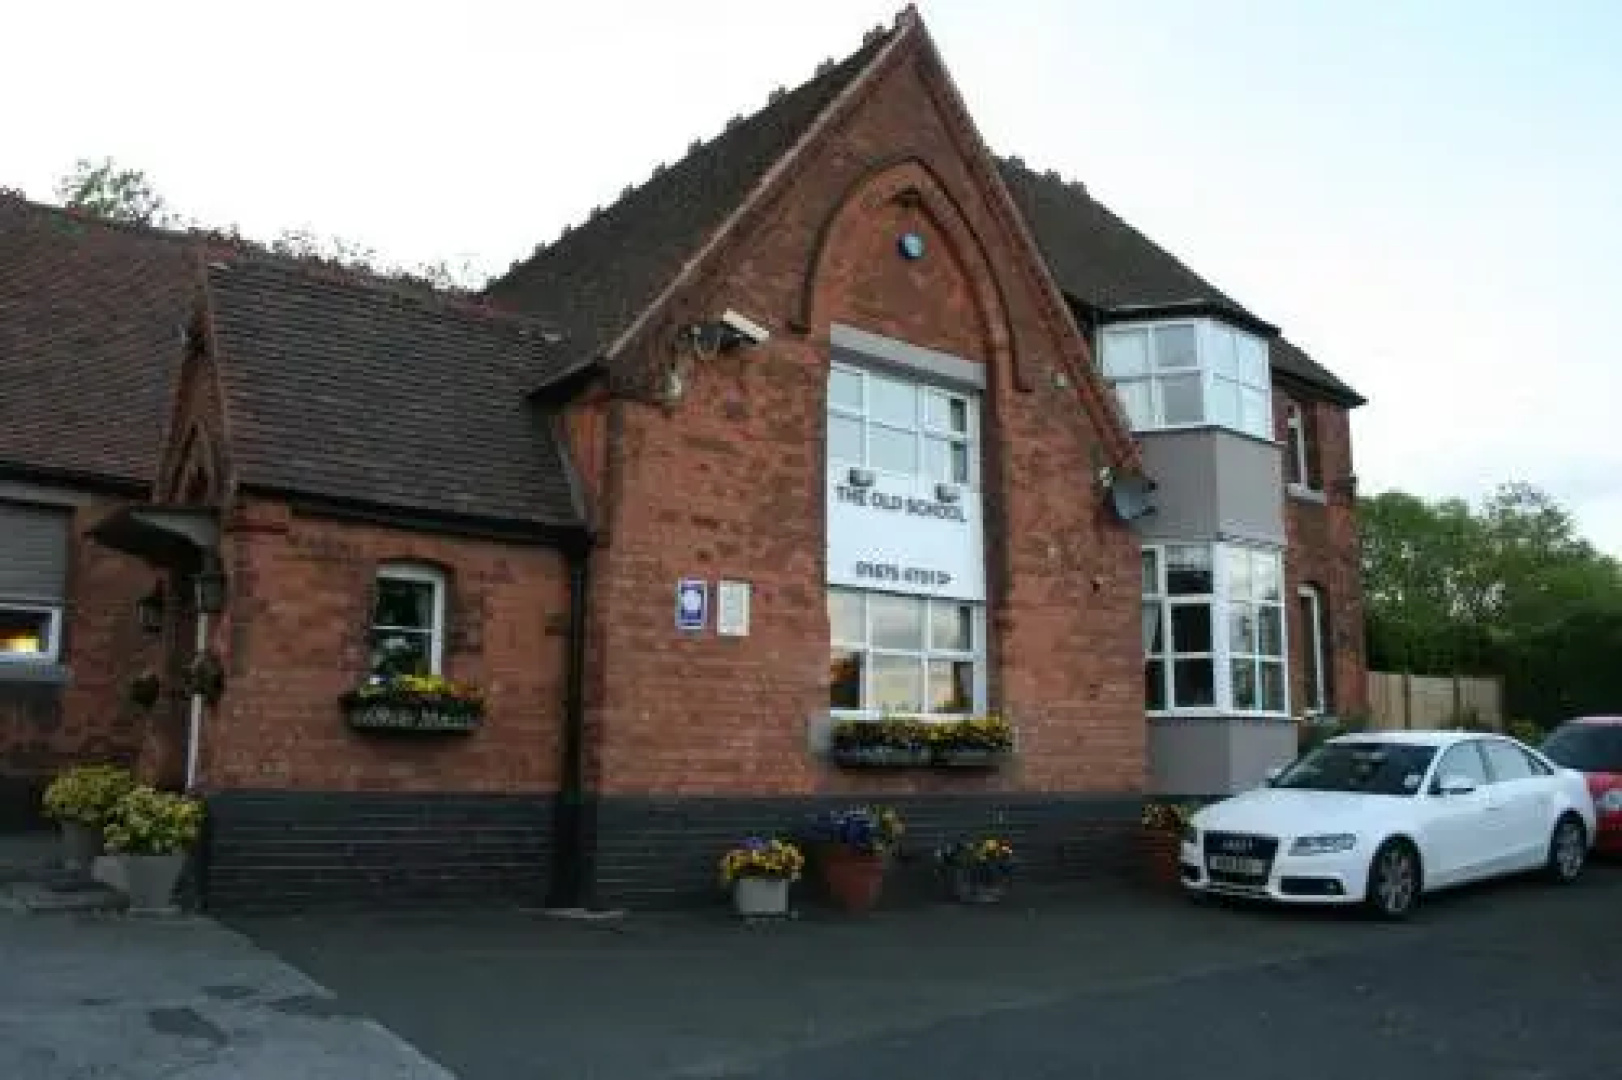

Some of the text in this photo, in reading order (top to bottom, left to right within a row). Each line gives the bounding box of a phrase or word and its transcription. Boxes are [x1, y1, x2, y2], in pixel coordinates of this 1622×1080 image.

[836, 486, 967, 523] THE OLD SCHOOL
